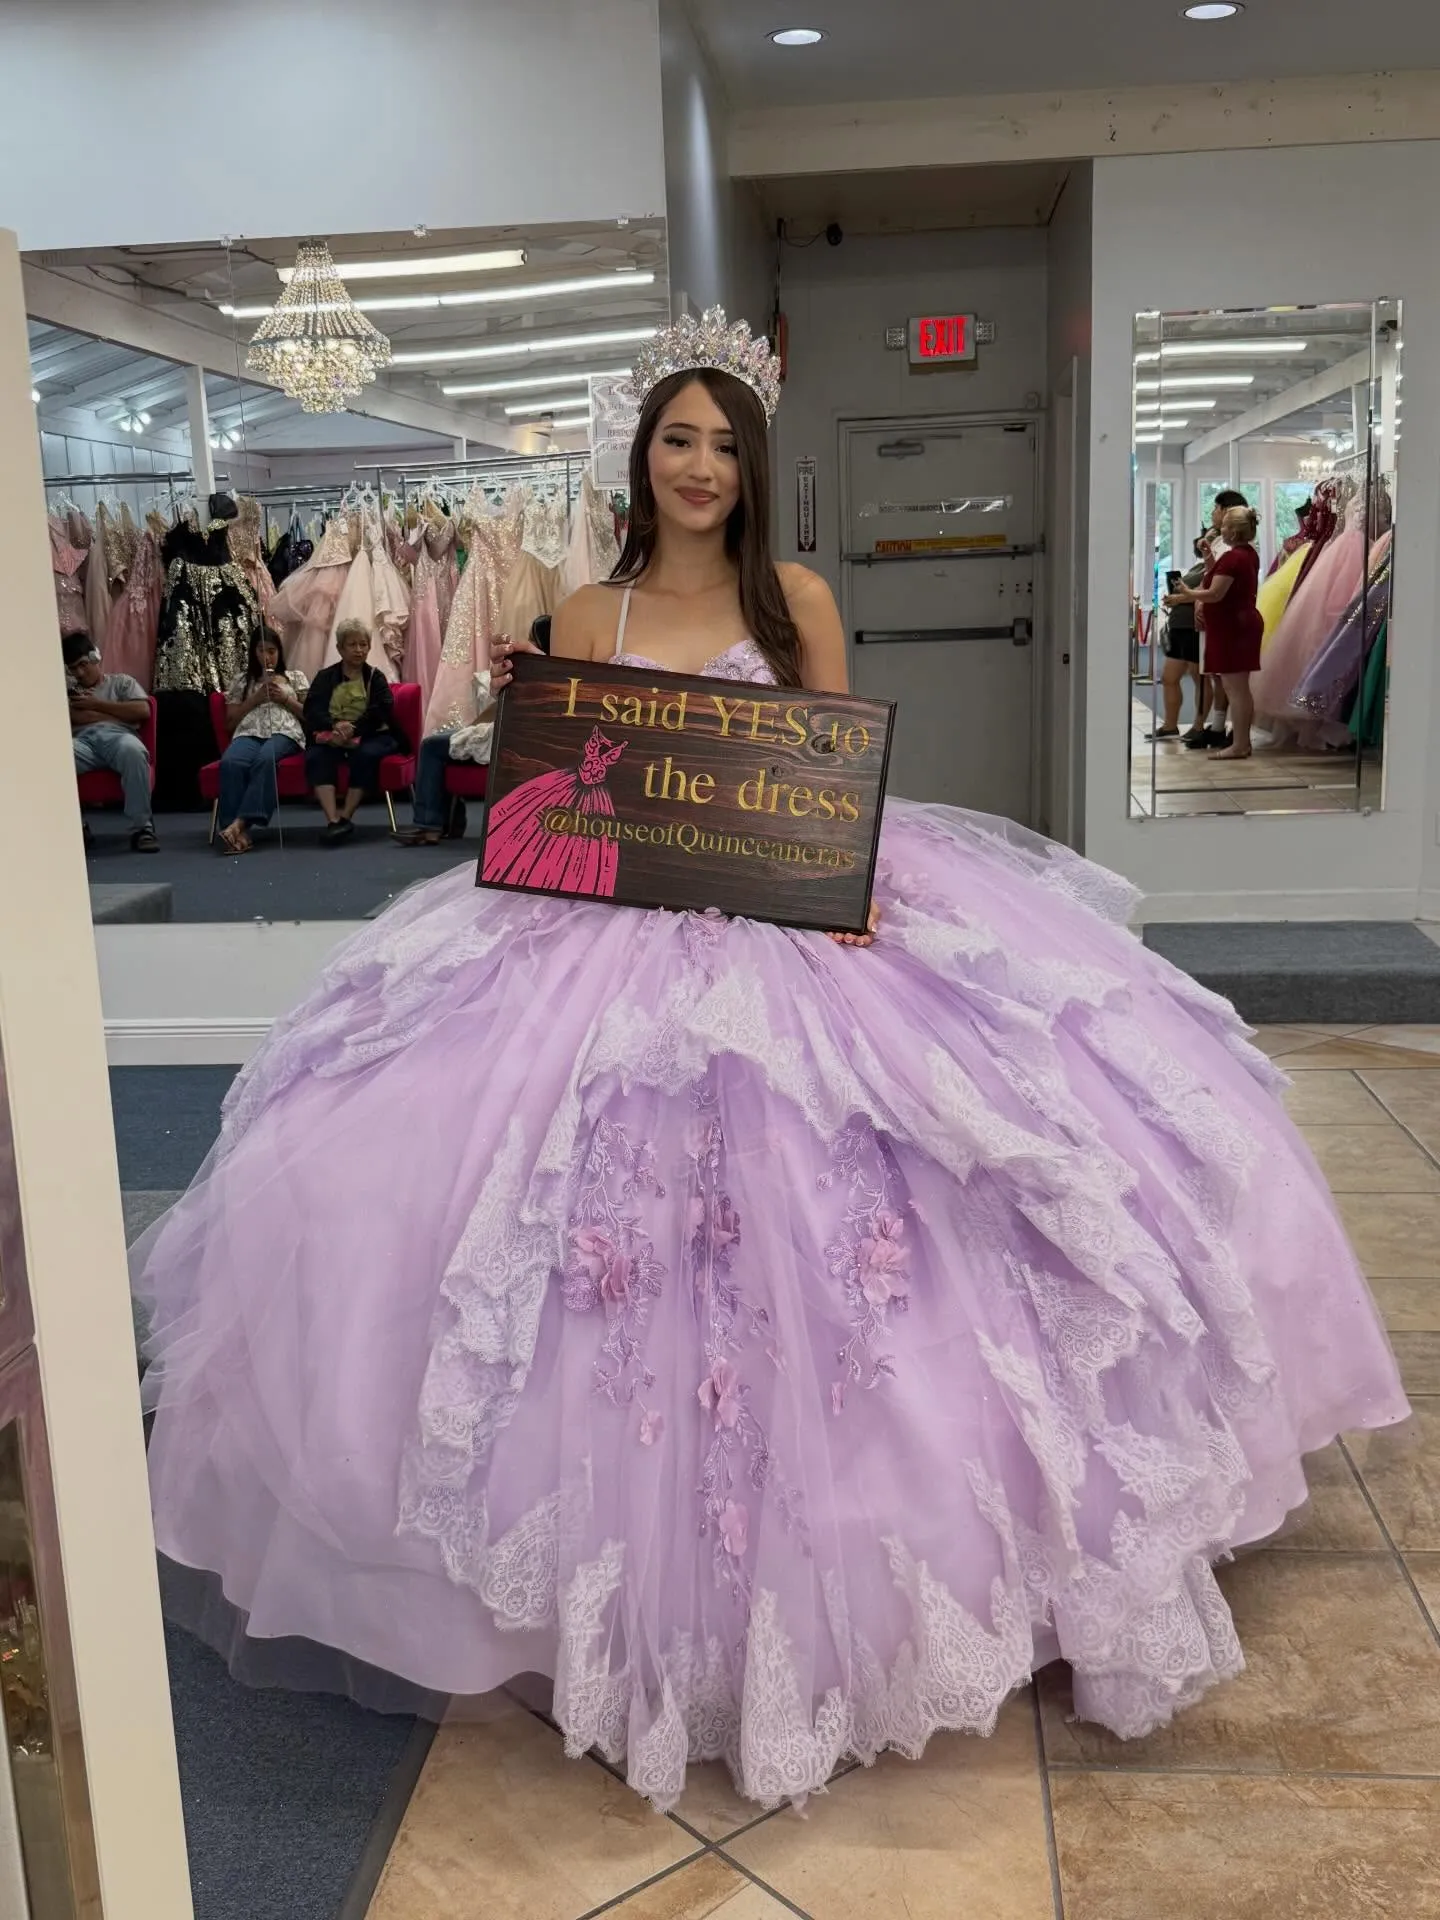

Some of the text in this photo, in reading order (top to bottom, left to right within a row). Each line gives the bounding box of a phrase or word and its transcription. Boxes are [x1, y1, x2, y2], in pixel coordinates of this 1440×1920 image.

[919, 316, 966, 356] EXIT
[799, 466, 814, 475] FIRE
[875, 540, 912, 553] CAUTION
[562, 677, 871, 754] I said YES to
[643, 756, 860, 823] the dress
